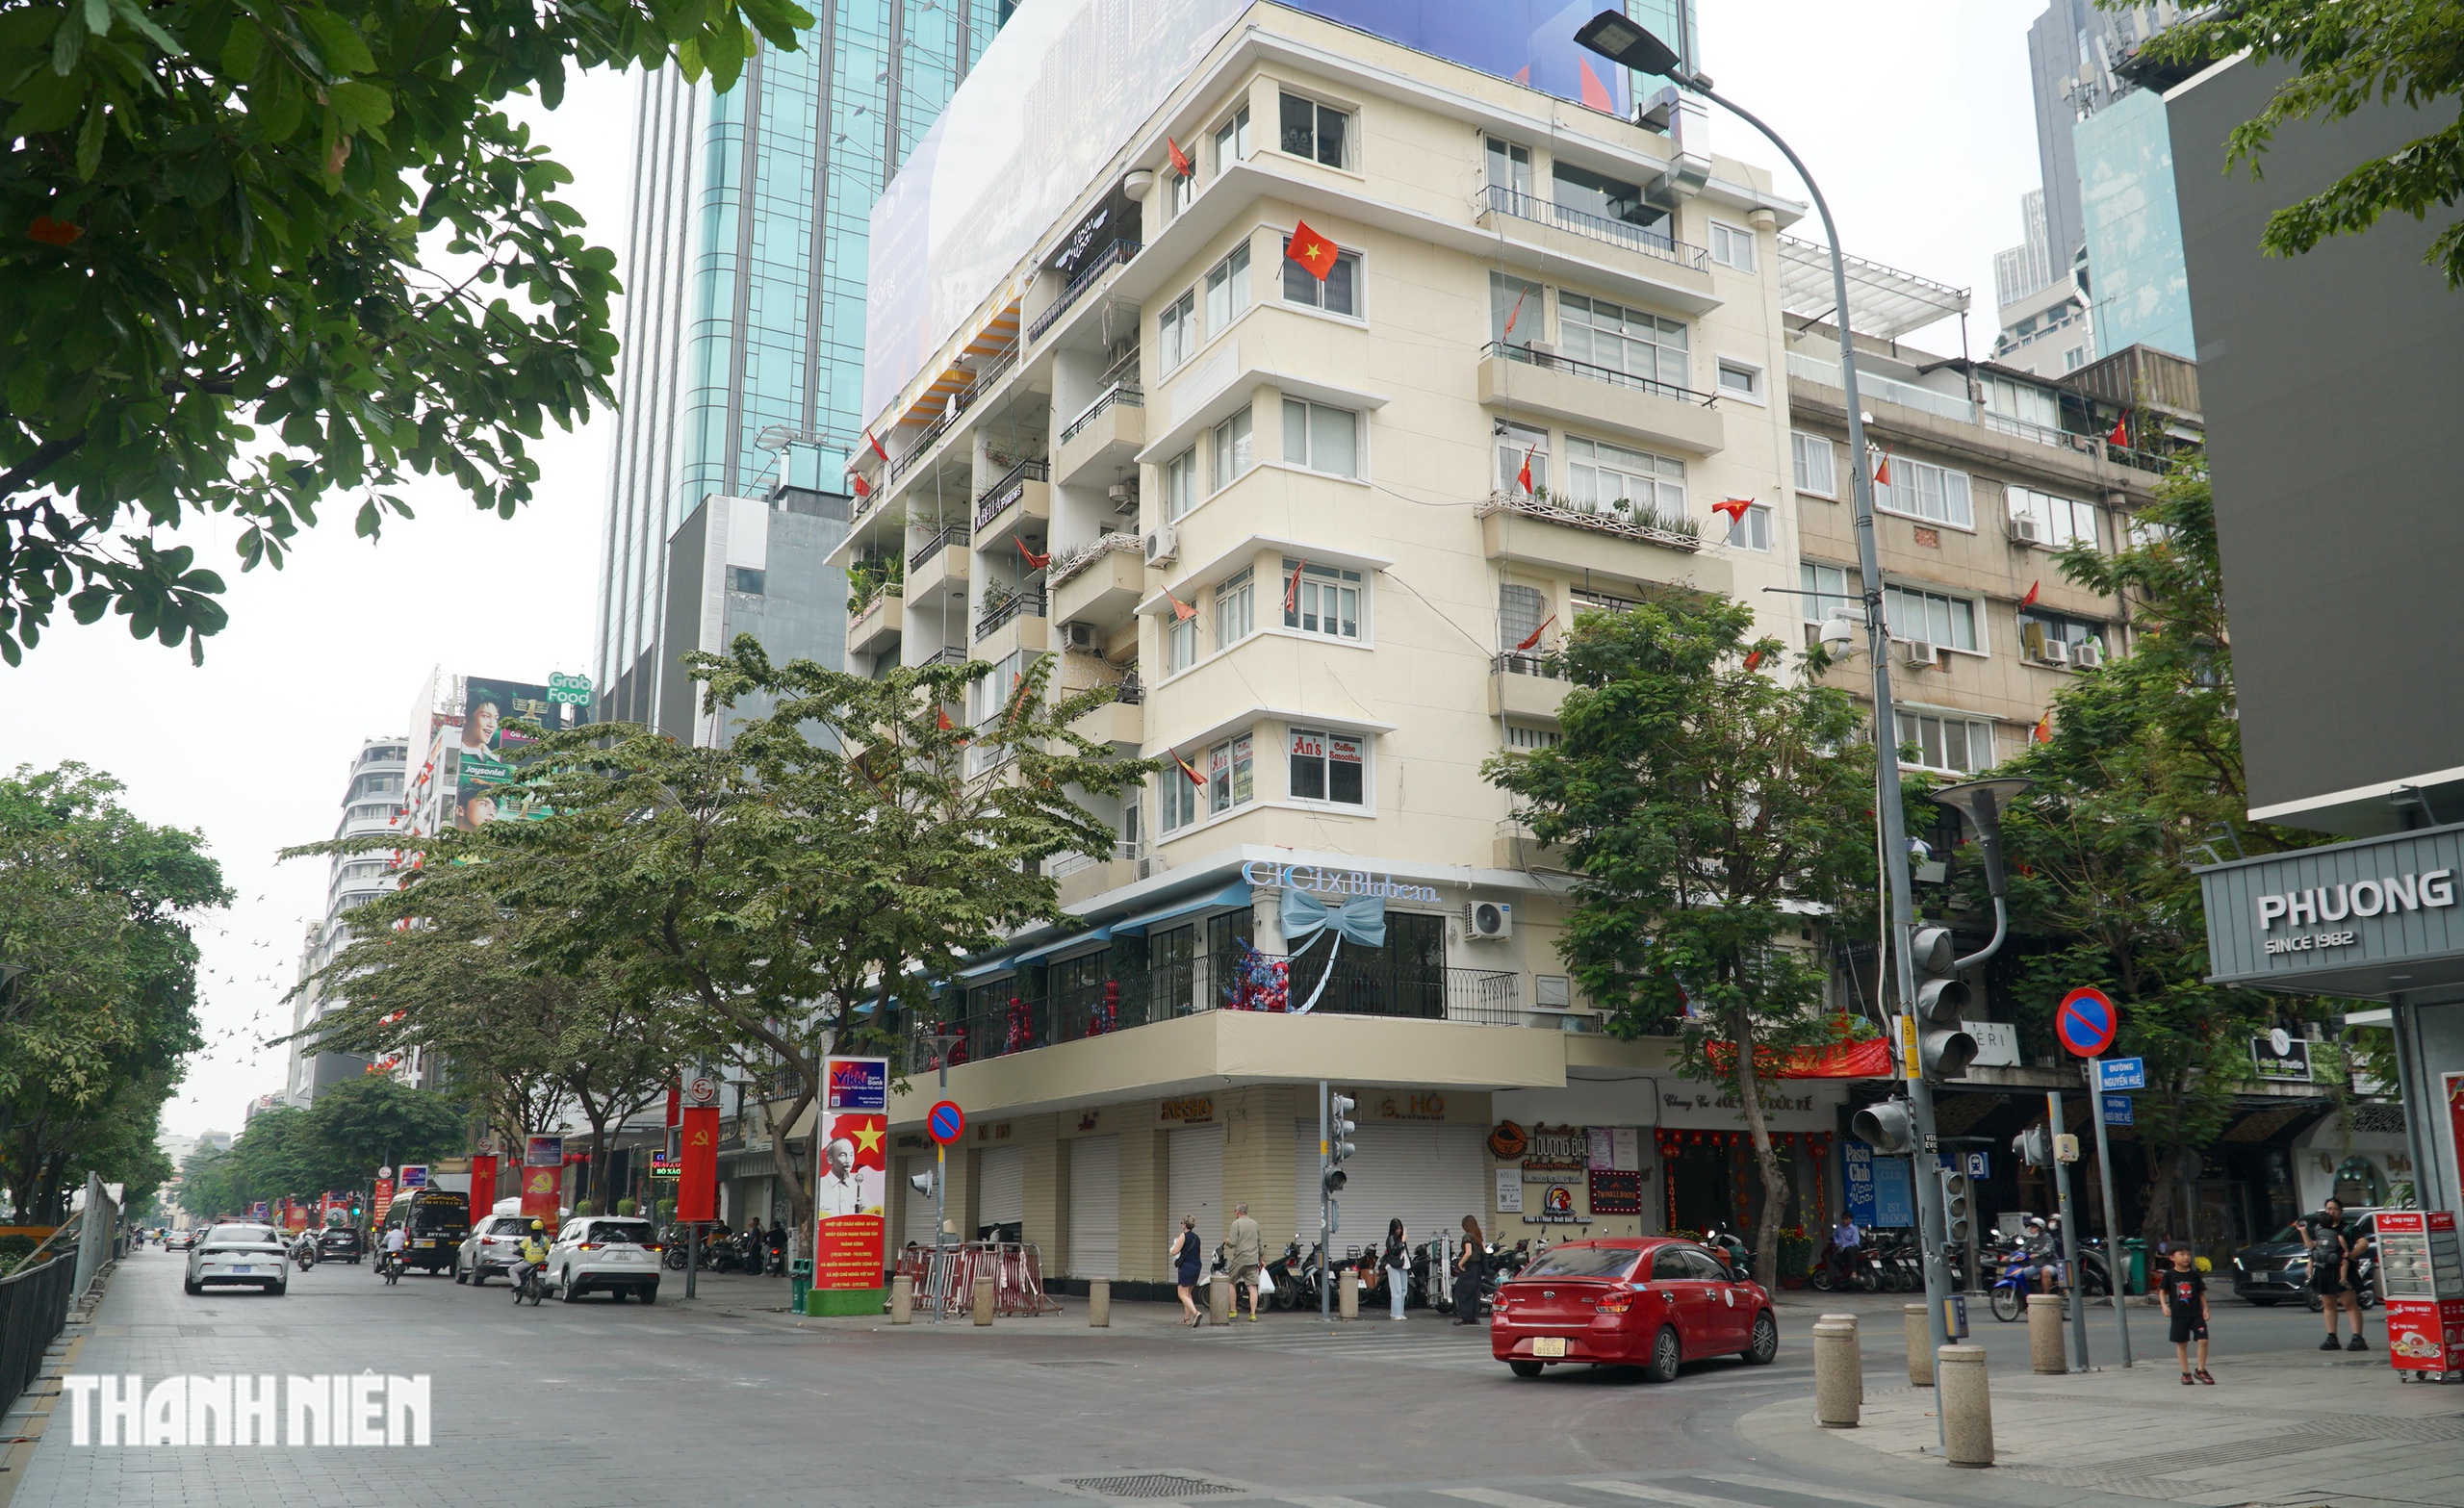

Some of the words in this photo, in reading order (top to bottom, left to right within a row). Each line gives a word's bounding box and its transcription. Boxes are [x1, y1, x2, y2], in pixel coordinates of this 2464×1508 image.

[550, 673, 592, 690] Grab
[549, 688, 590, 704] Food
[1293, 736, 1322, 756] An's
[1334, 741, 1356, 753] Coffee
[1329, 751, 1361, 763] Smoothie
[2257, 868, 2454, 931] PHUONG
[2265, 935, 2312, 955] SINCE
[2314, 931, 2354, 948] 1982
[2109, 1062, 2134, 1072] ĐƯỜNG
[2279, 1059, 2304, 1069] Studio
[833, 1065, 867, 1086] Vikki
[1845, 1144, 1871, 1163] Pasta
[1849, 1163, 1871, 1182] Club
[1881, 1214, 1909, 1224] FLOOR
